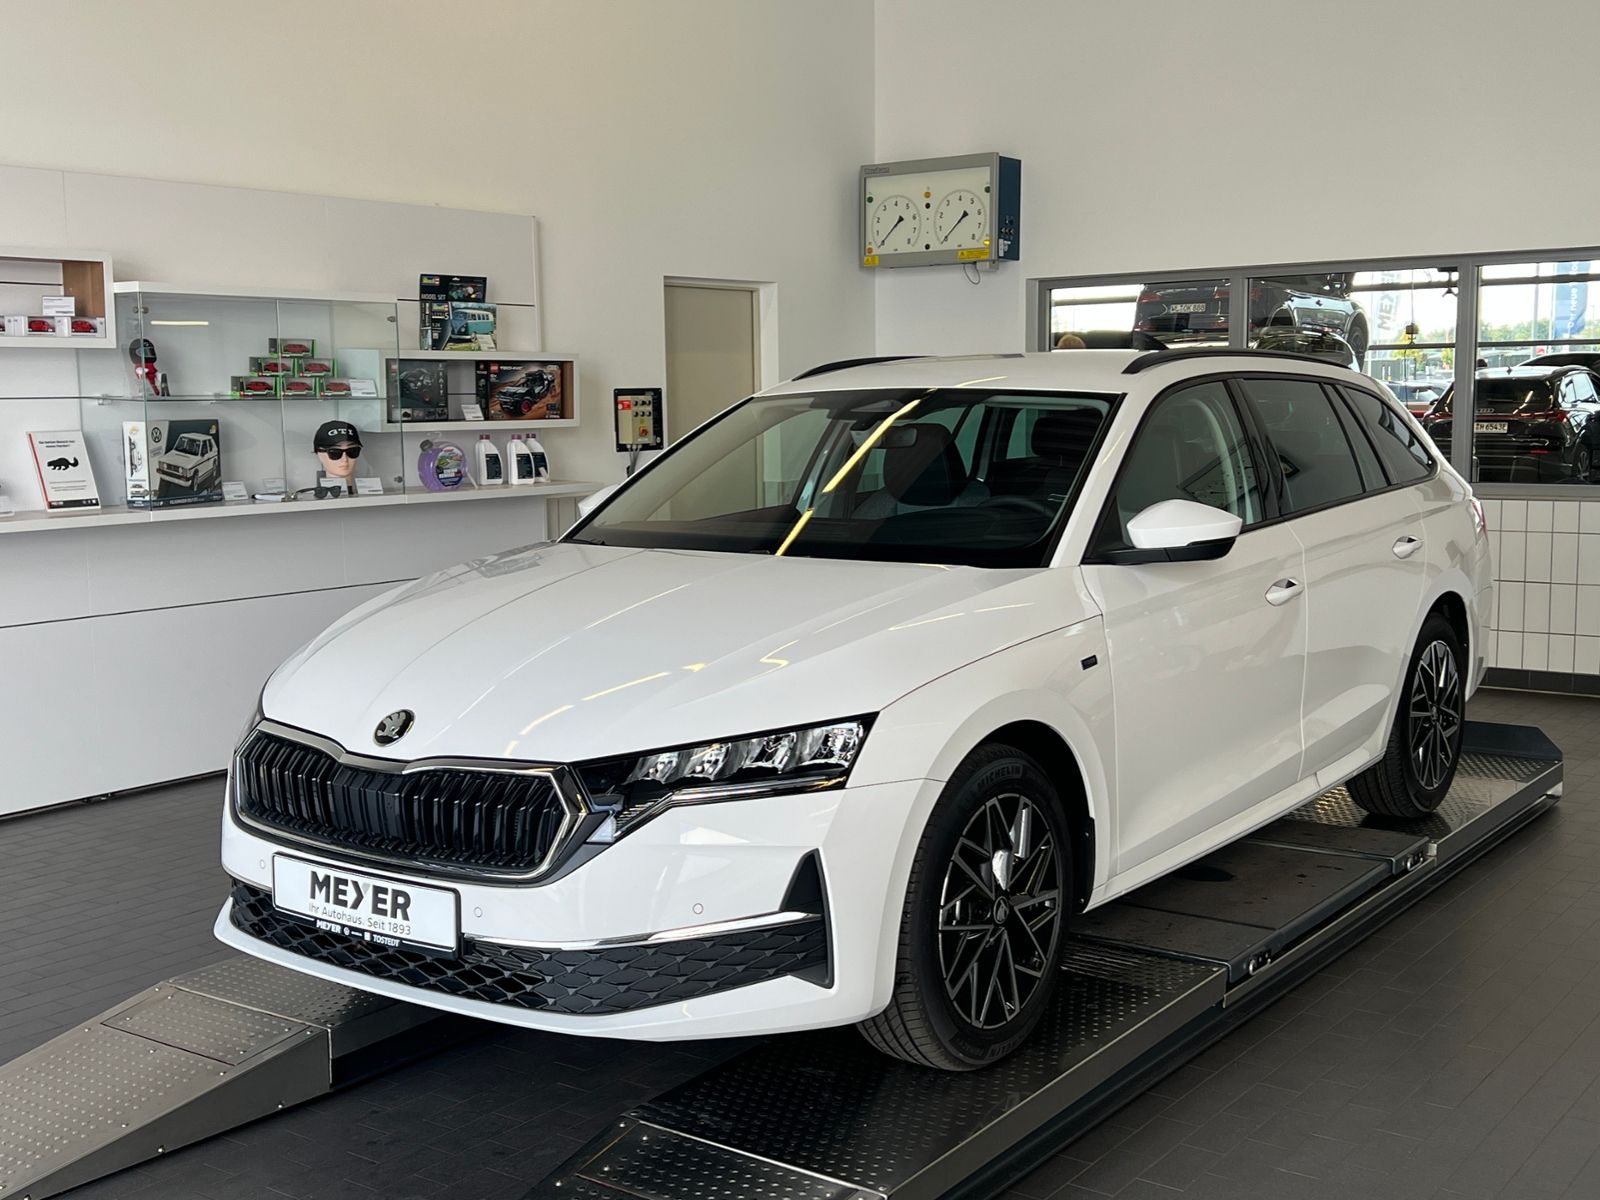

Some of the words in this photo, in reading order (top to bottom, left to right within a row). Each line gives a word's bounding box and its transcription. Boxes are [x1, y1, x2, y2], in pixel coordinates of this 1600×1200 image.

[328, 428, 354, 436] GTI
[310, 870, 411, 921] MEYER
[308, 902, 320, 914] Ihr
[367, 917, 385, 931] Seit
[388, 921, 411, 935] 1893
[316, 919, 342, 934] MEYER
[373, 934, 400, 947] TOSTEDT
